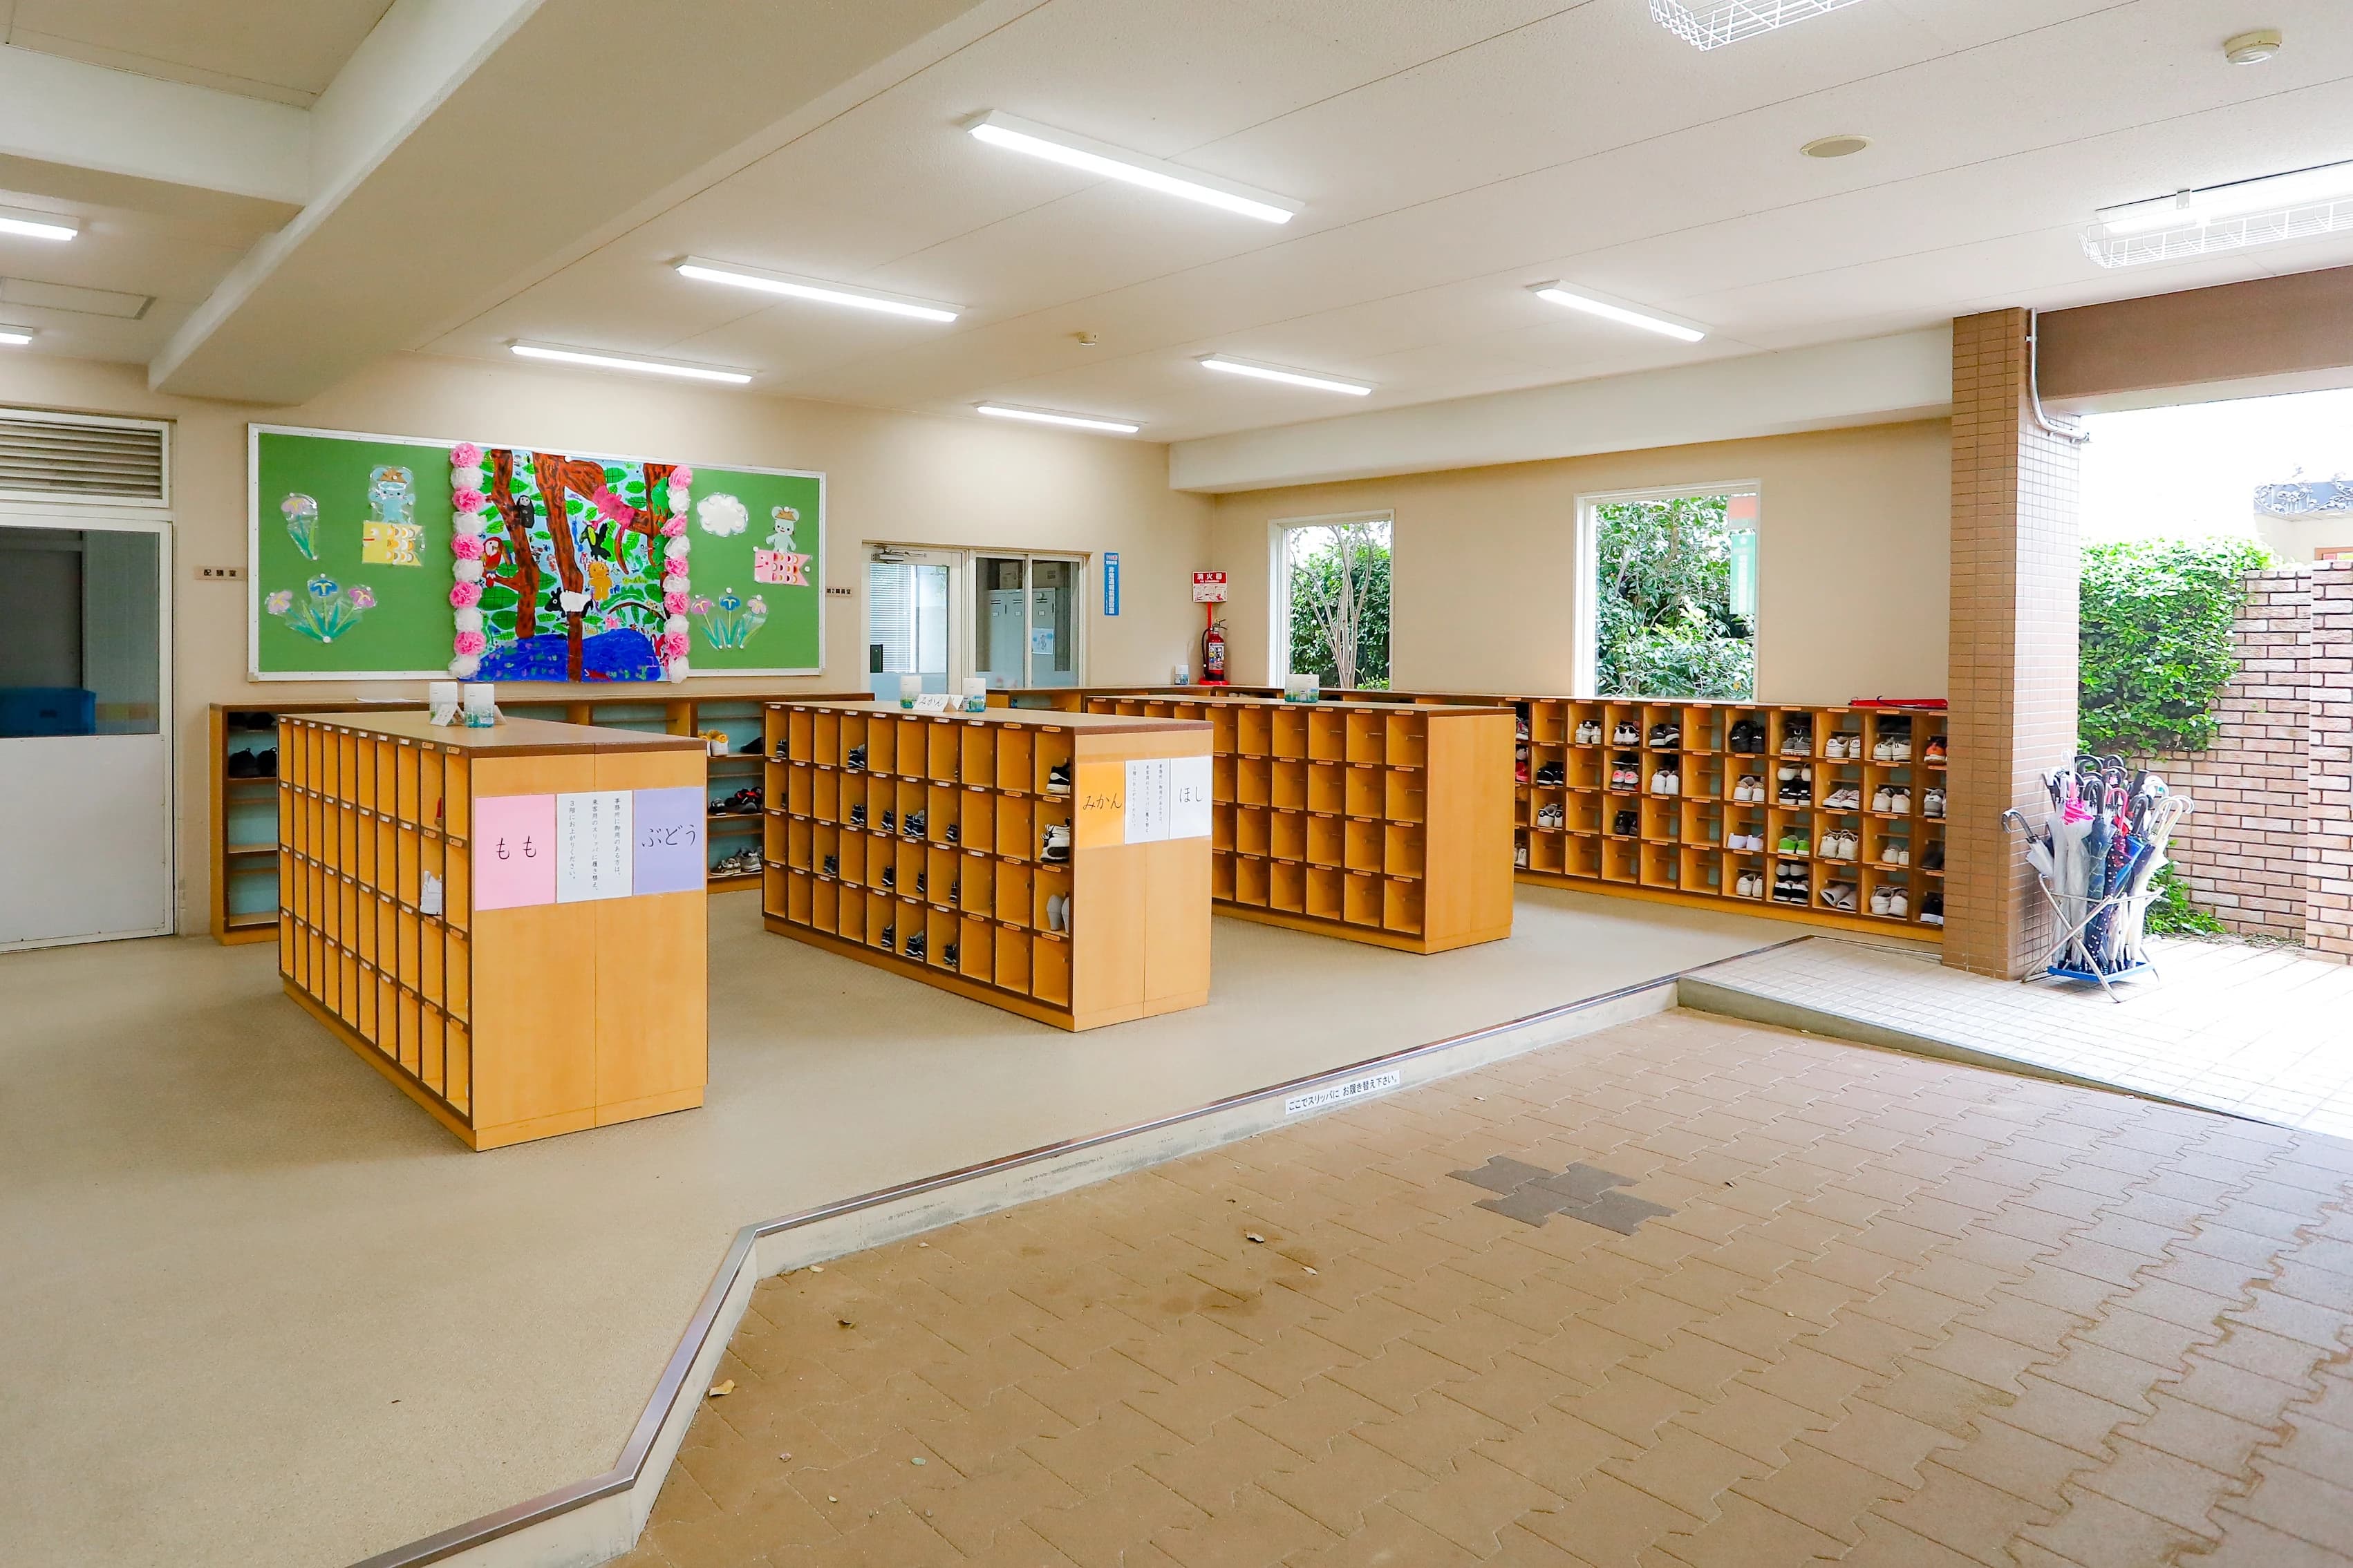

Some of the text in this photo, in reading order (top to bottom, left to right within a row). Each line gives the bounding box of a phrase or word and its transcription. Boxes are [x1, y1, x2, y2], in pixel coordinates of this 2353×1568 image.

[1082, 793, 1123, 811] みかん
[1179, 786, 1203, 802] ほし
[641, 824, 697, 847] ぶどう
[496, 835, 536, 860] もも
[1288, 1090, 1340, 1111] ここでスリッパに
